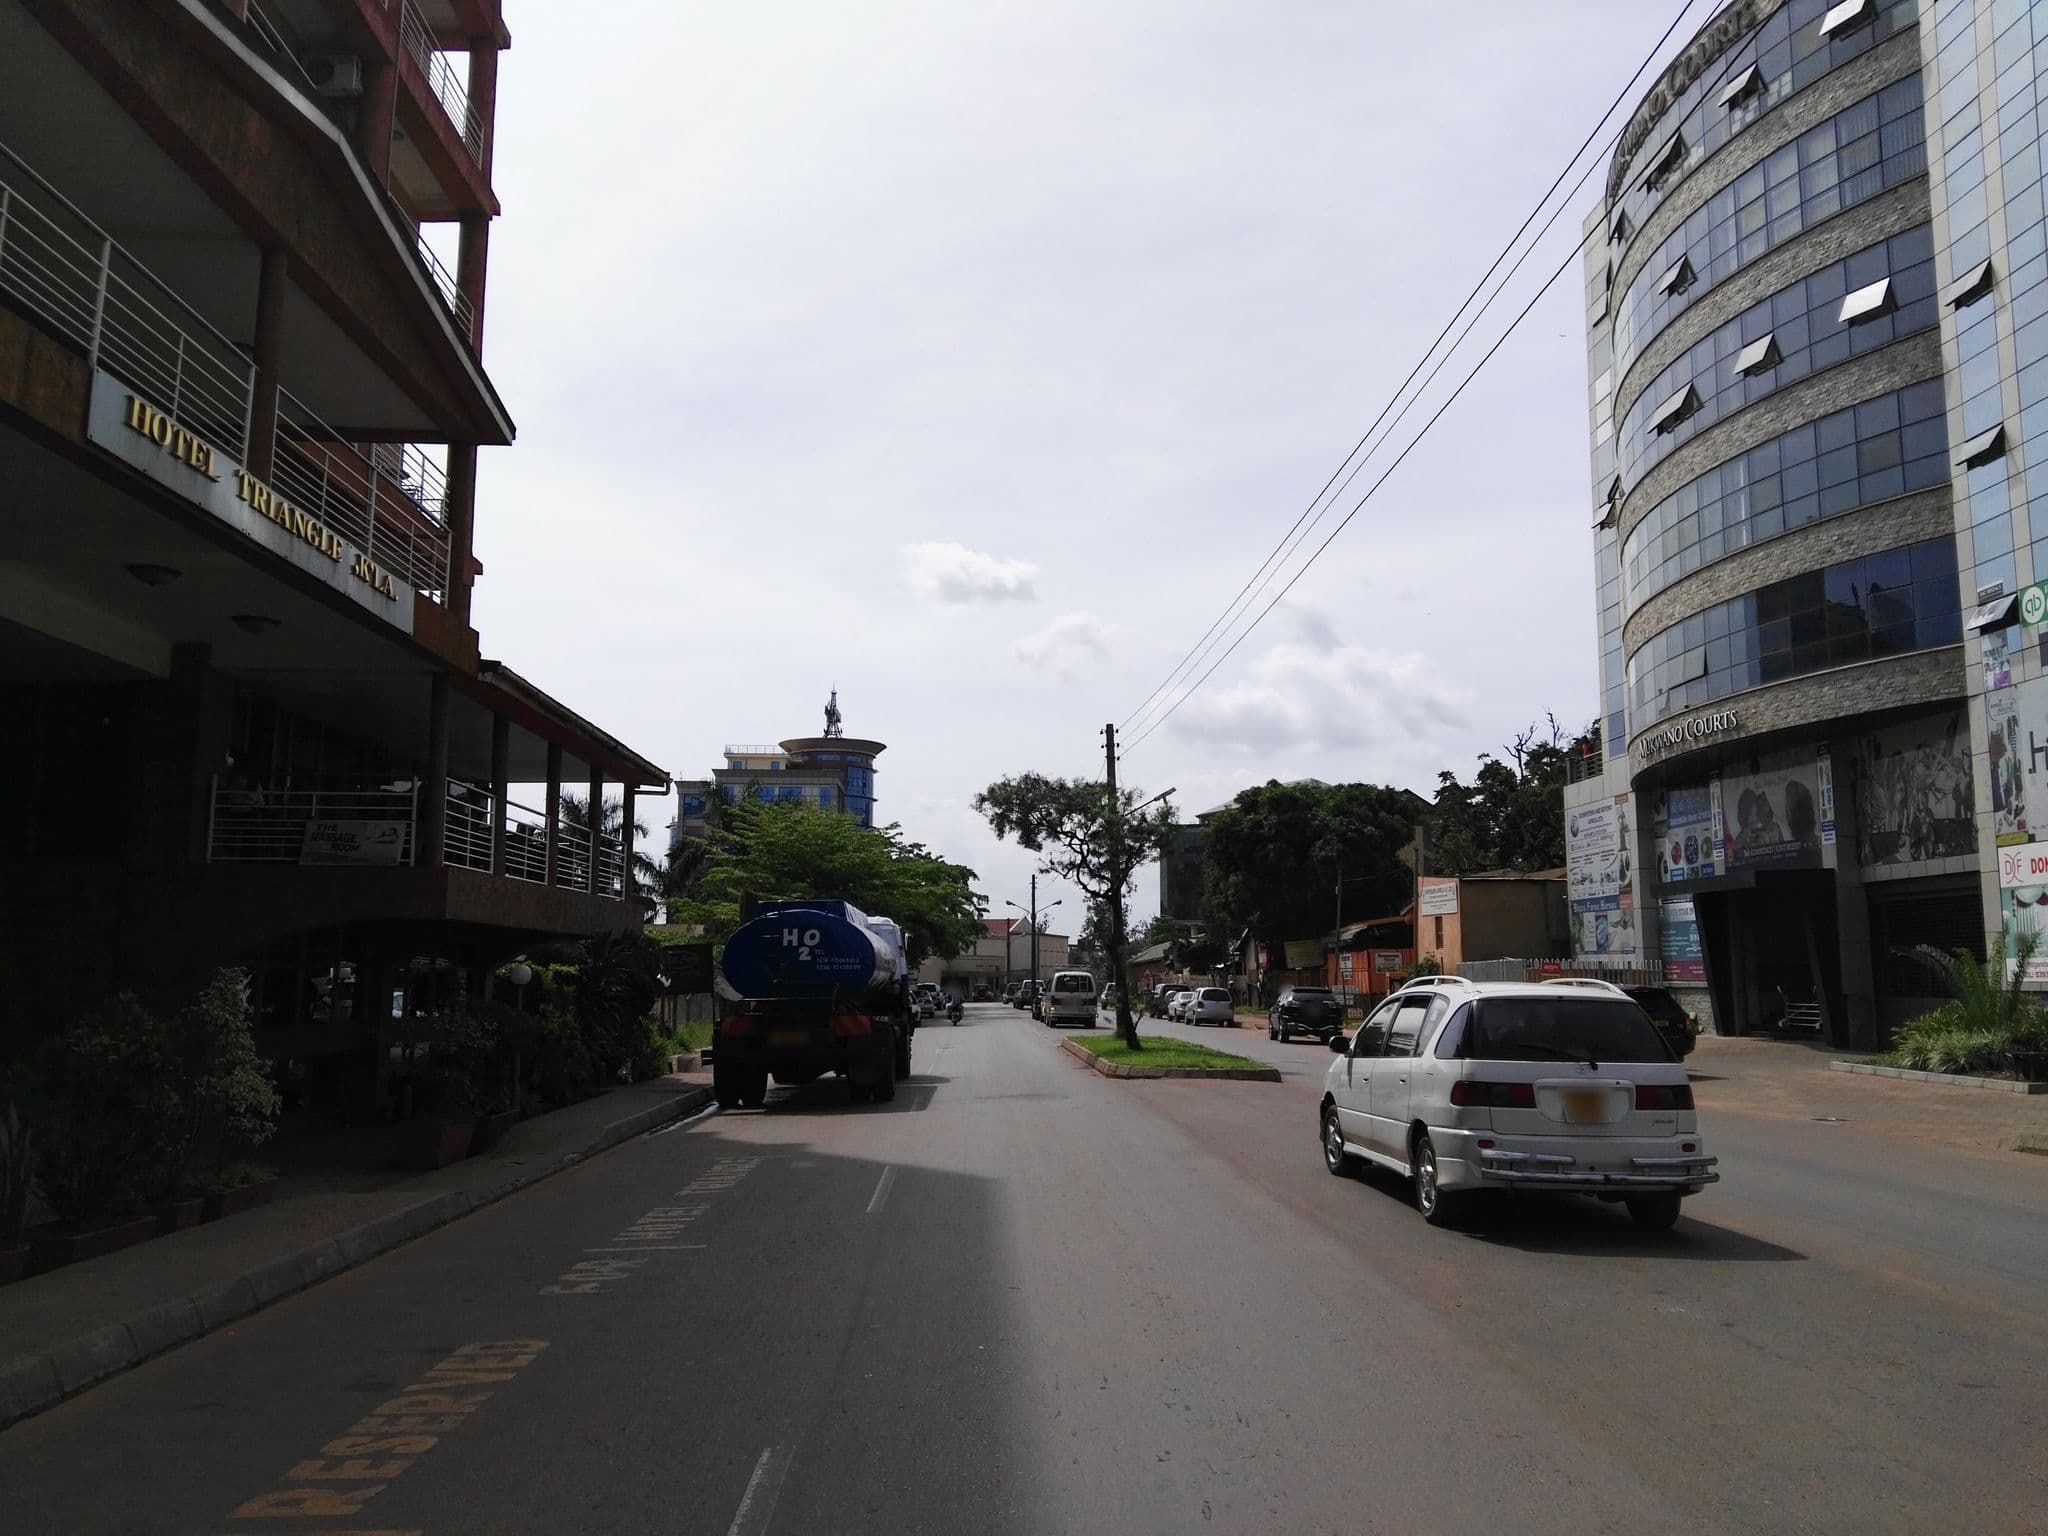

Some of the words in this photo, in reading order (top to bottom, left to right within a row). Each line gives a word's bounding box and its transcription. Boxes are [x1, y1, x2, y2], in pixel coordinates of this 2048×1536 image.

[125, 394, 222, 482] HOTEL
[233, 469, 343, 563] TRIANGLE
[1685, 710, 1738, 740] COURTS
[225, 1340, 550, 1519] RESERVED
